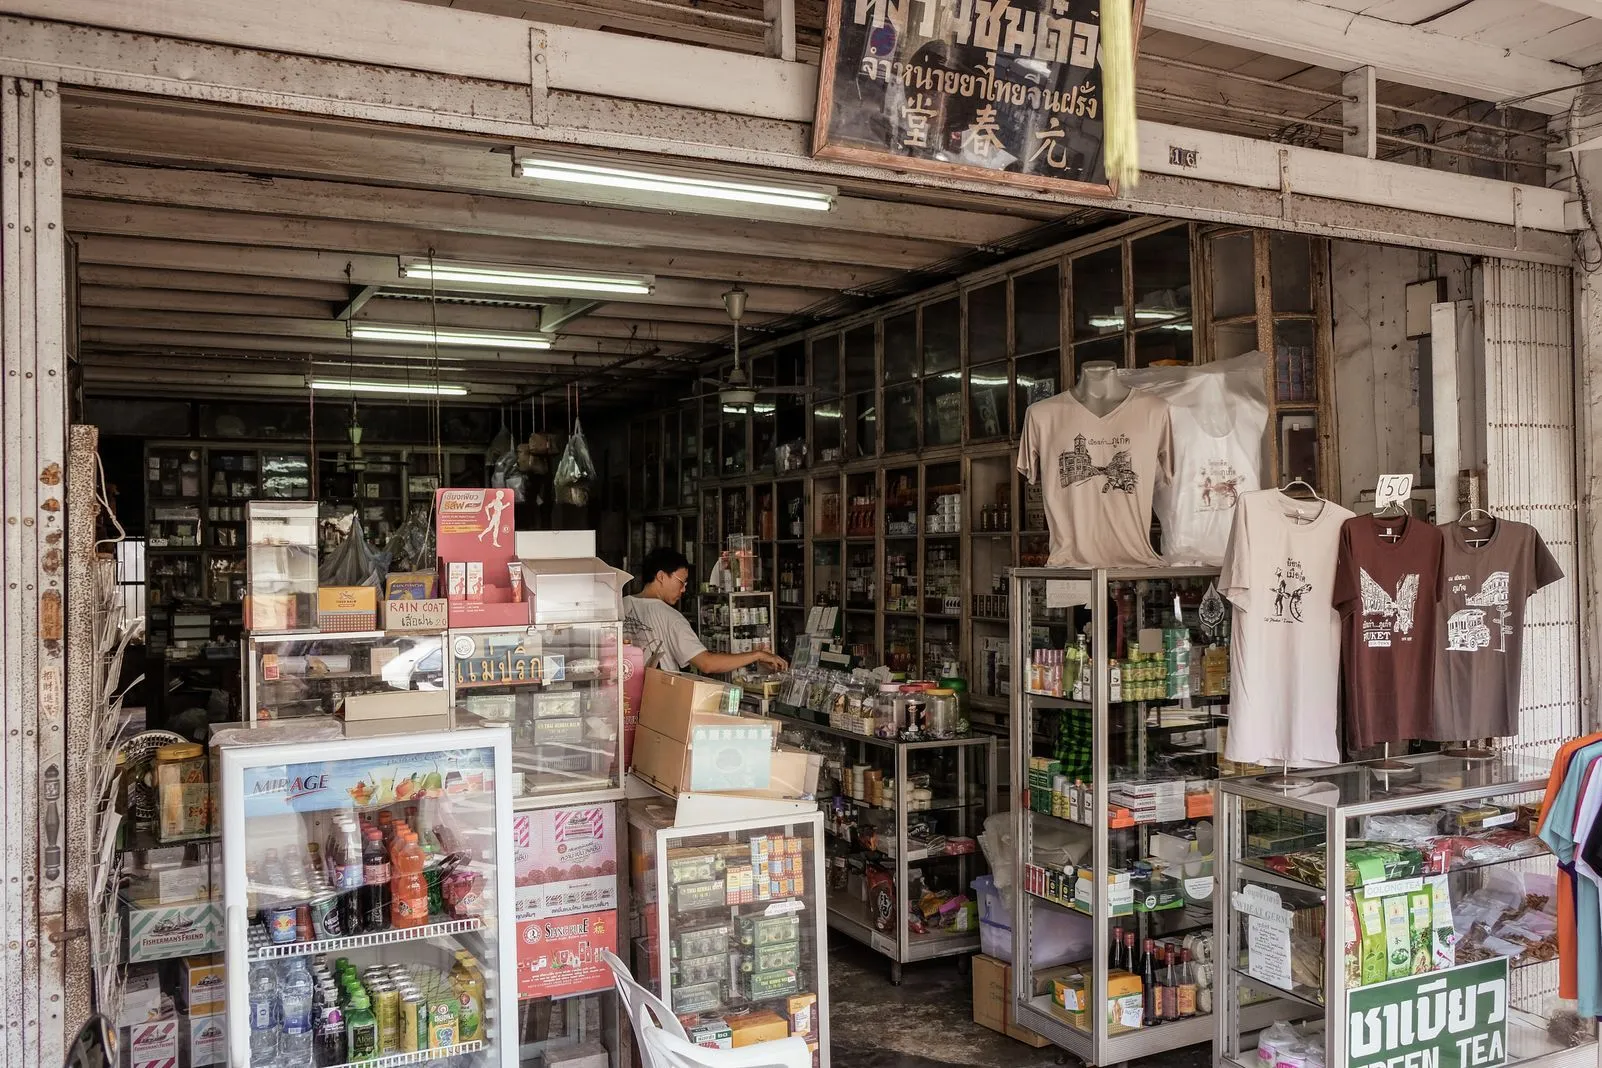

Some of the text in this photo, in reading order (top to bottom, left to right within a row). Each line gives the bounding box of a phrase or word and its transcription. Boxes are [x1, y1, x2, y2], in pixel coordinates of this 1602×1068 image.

[861, 46, 1098, 119] จำหน่ายยาไทยจีนฝรั่ง
[1172, 148, 1196, 166] 16
[1378, 475, 1410, 497] 150
[390, 602, 418, 613] RAIN
[422, 602, 445, 613] COAT
[401, 613, 434, 627] เสื้อฝน
[253, 774, 329, 794] MIRAGE
[181, 932, 204, 943] FRIEND
[1350, 977, 1506, 1059] ชาเขียว
[1455, 1030, 1504, 1068] TEA
